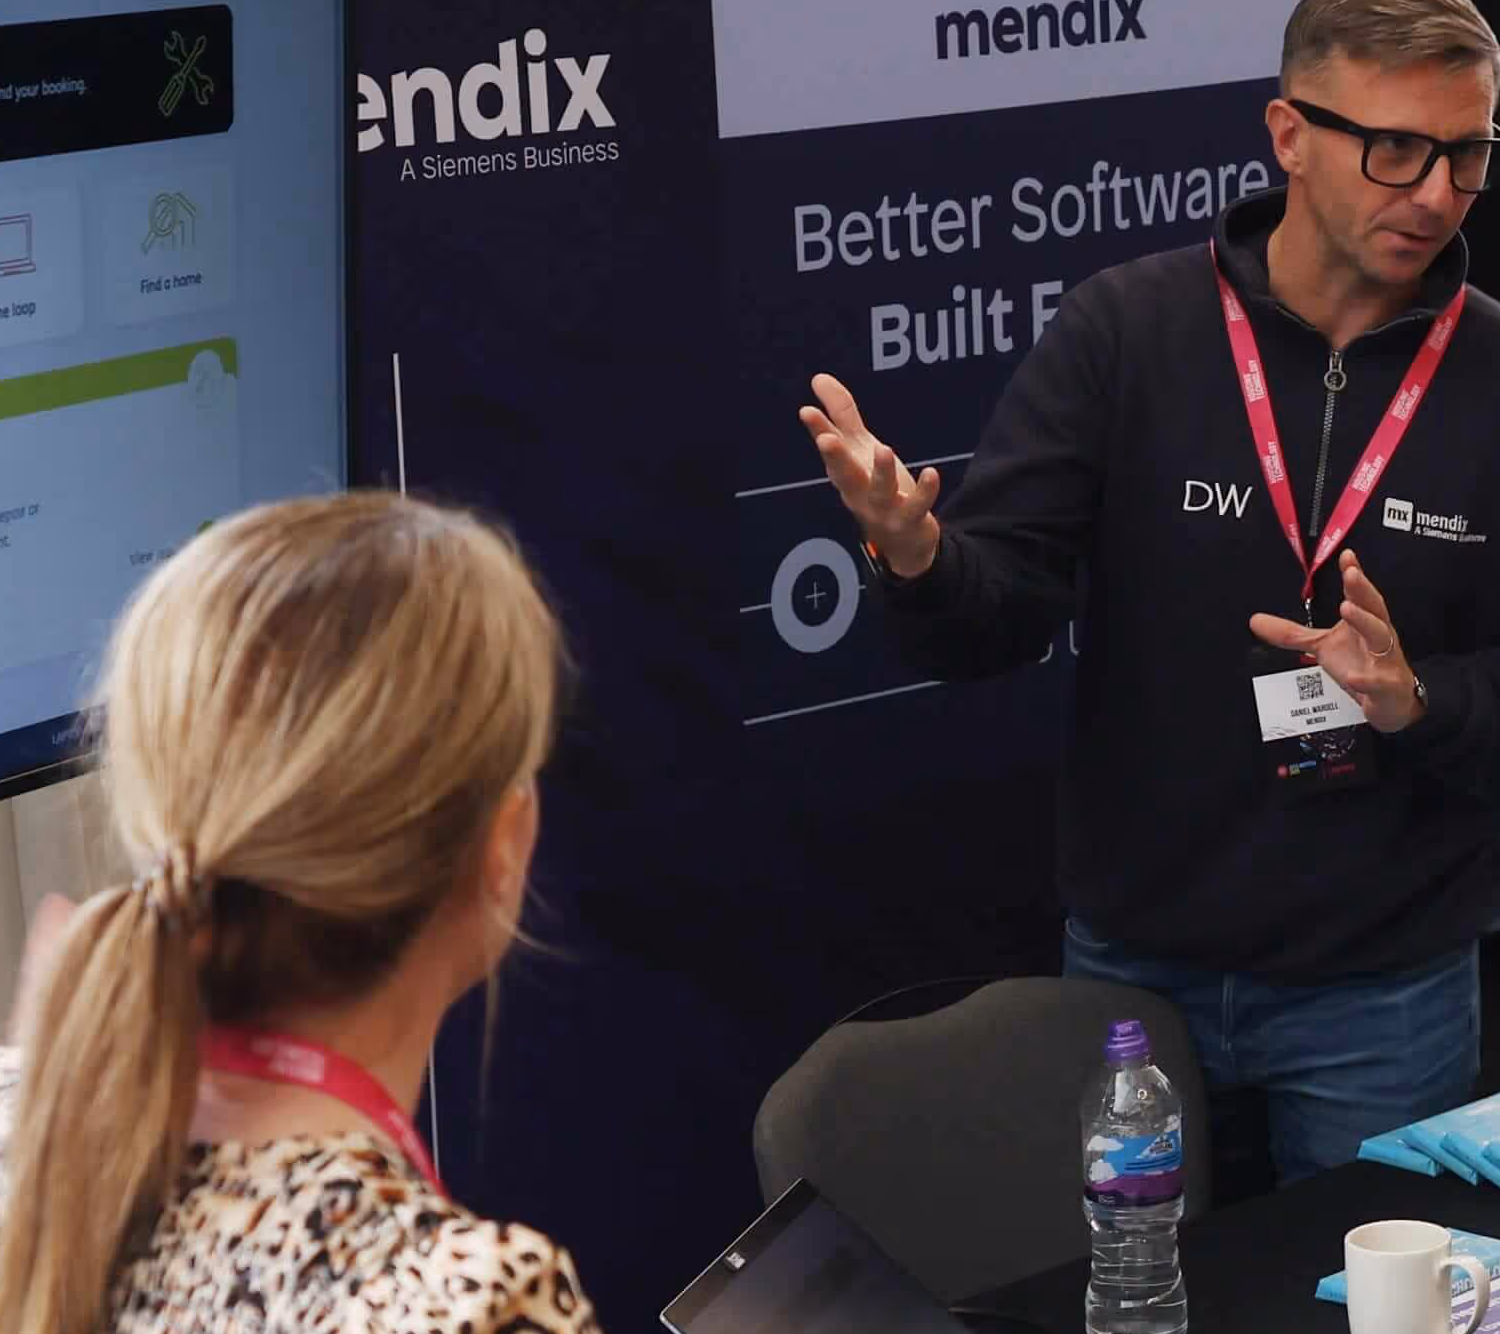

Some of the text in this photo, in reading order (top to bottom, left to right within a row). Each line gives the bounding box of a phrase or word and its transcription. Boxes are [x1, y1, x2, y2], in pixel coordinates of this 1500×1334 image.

[15, 83, 41, 103] your
[42, 76, 87, 96] booking.
[401, 141, 620, 182] A Siemens Business
[794, 159, 1269, 273] Better Software
[140, 278, 163, 295] Find
[173, 271, 203, 290] home
[12, 298, 37, 321] loop
[870, 285, 1014, 372] Built
[28, 502, 42, 516] or
[1182, 479, 1254, 519] DW
[1388, 507, 1410, 523] mx
[1416, 510, 1469, 533] mendix
